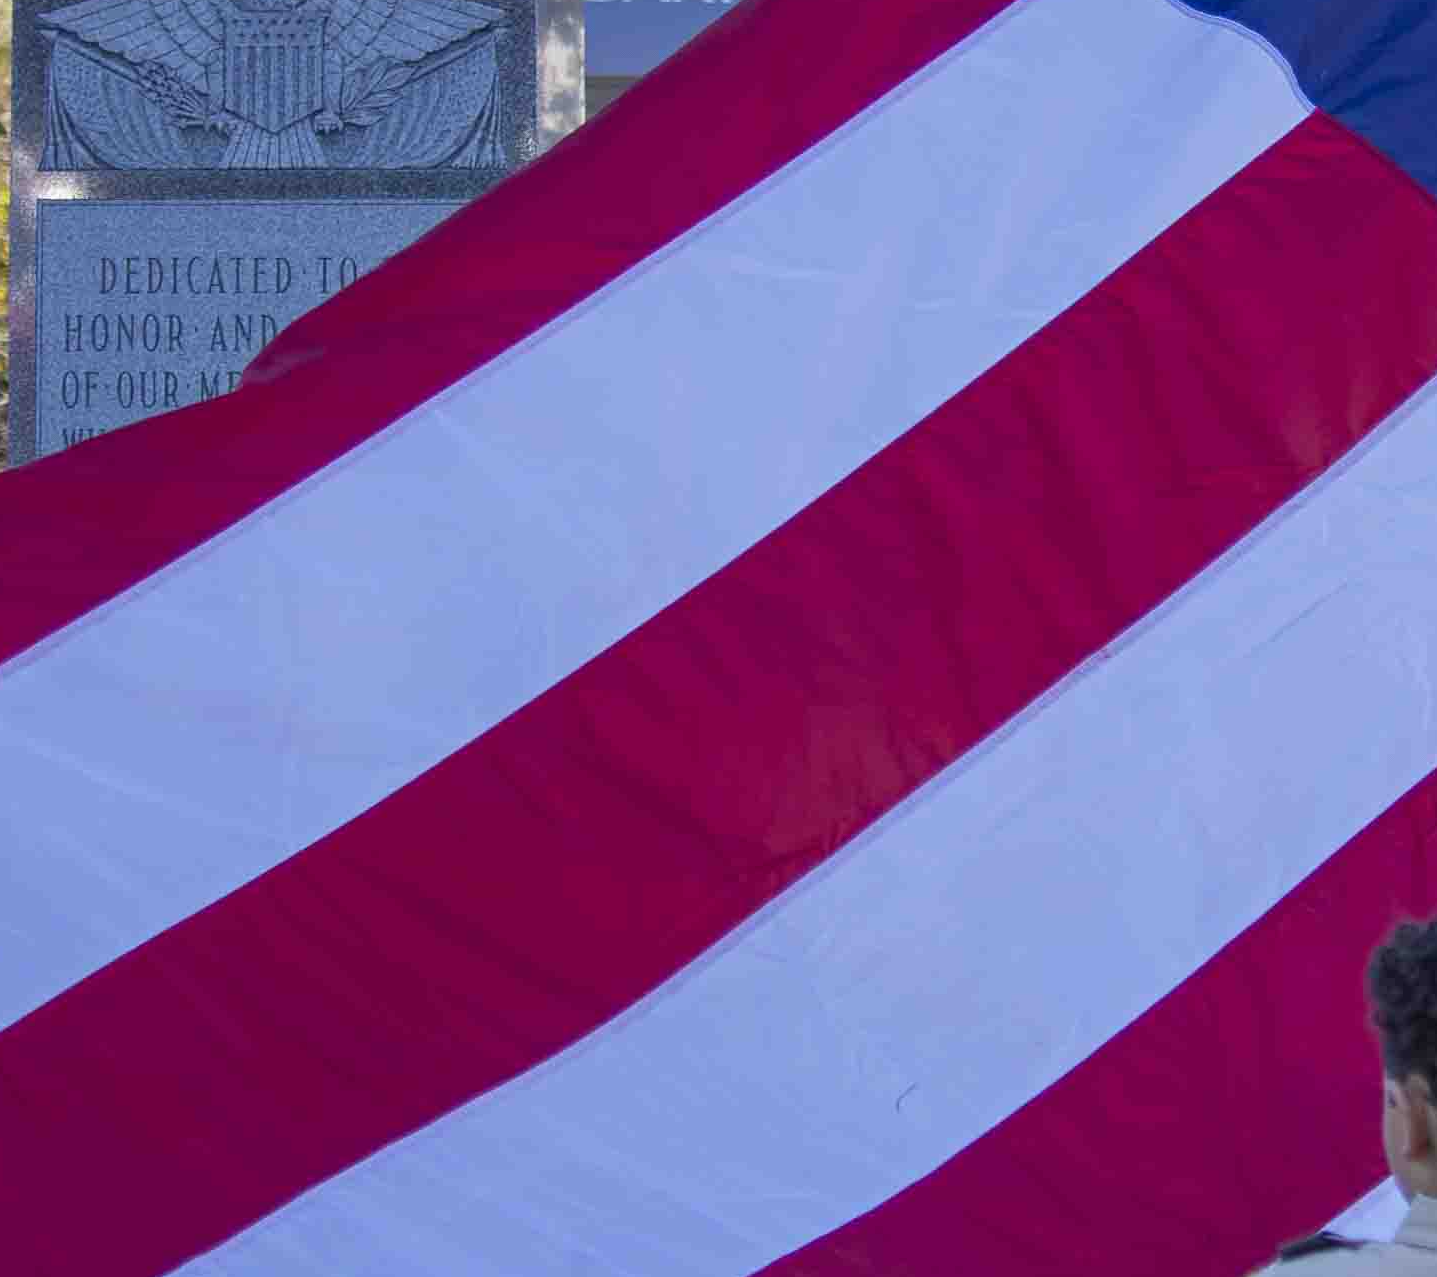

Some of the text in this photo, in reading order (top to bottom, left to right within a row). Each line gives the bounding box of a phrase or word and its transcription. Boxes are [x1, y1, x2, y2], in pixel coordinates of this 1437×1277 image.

[98, 256, 358, 295] DEDICATED TO
[64, 313, 281, 353] HONOR AND
[61, 370, 100, 410] OF
[116, 370, 181, 410] OUR
